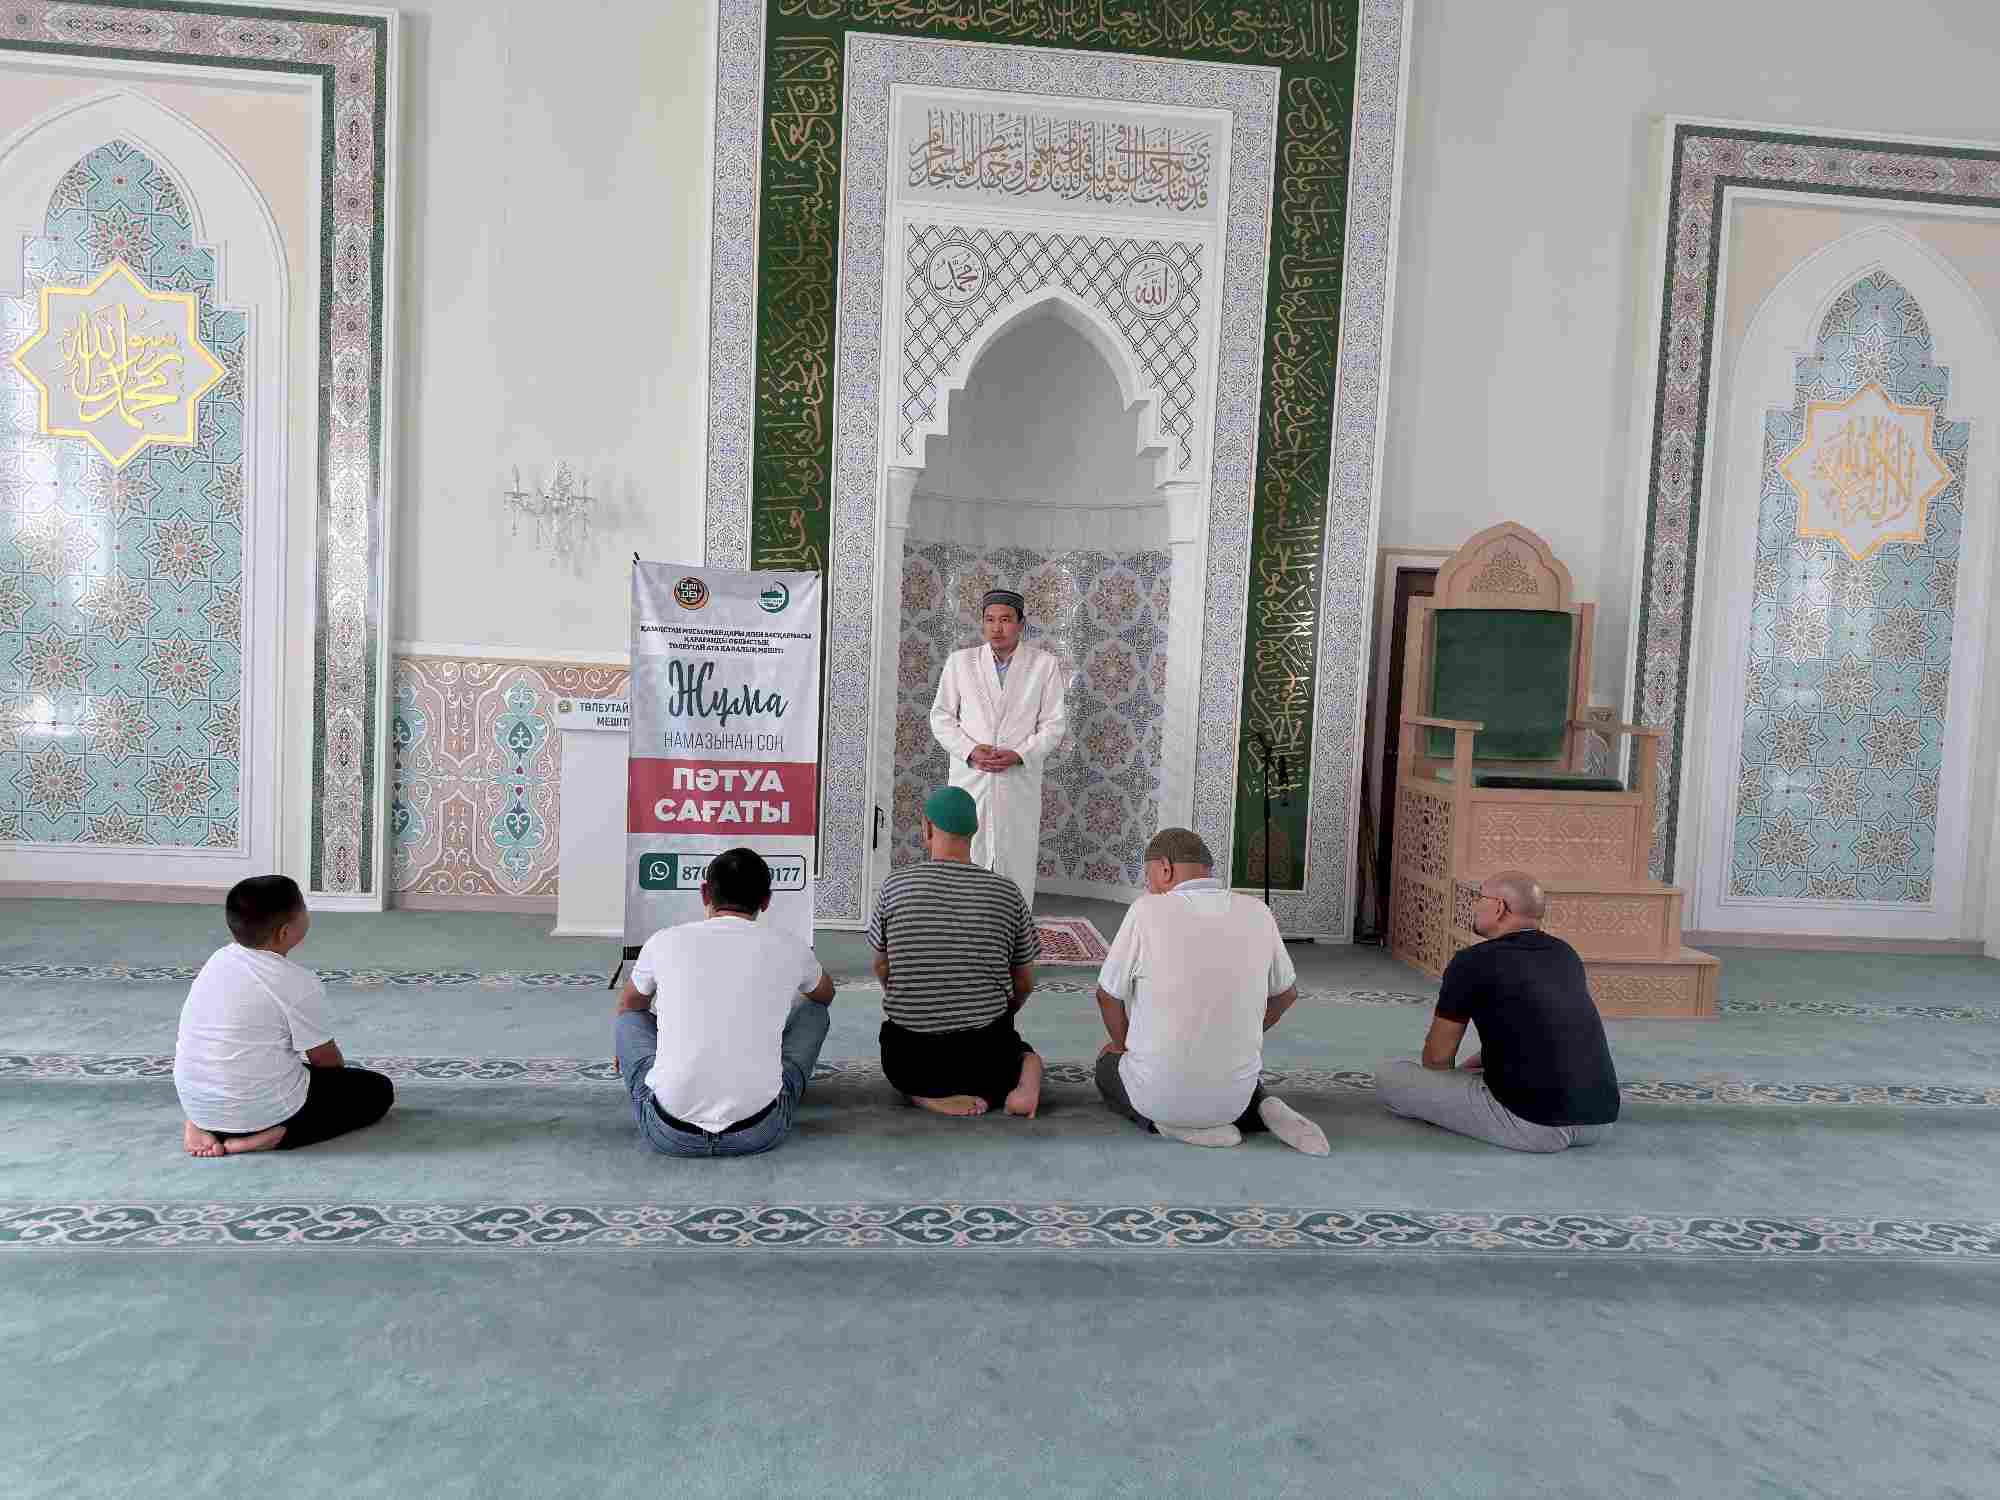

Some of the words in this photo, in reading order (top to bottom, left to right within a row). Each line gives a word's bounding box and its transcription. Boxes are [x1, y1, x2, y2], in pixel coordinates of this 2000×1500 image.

[668, 659, 789, 727] Жума
[664, 730, 753, 751] НАМАЗЫНАН
[672, 767, 785, 793] ПӘТУА
[654, 798, 790, 824] САҒАТЫ
